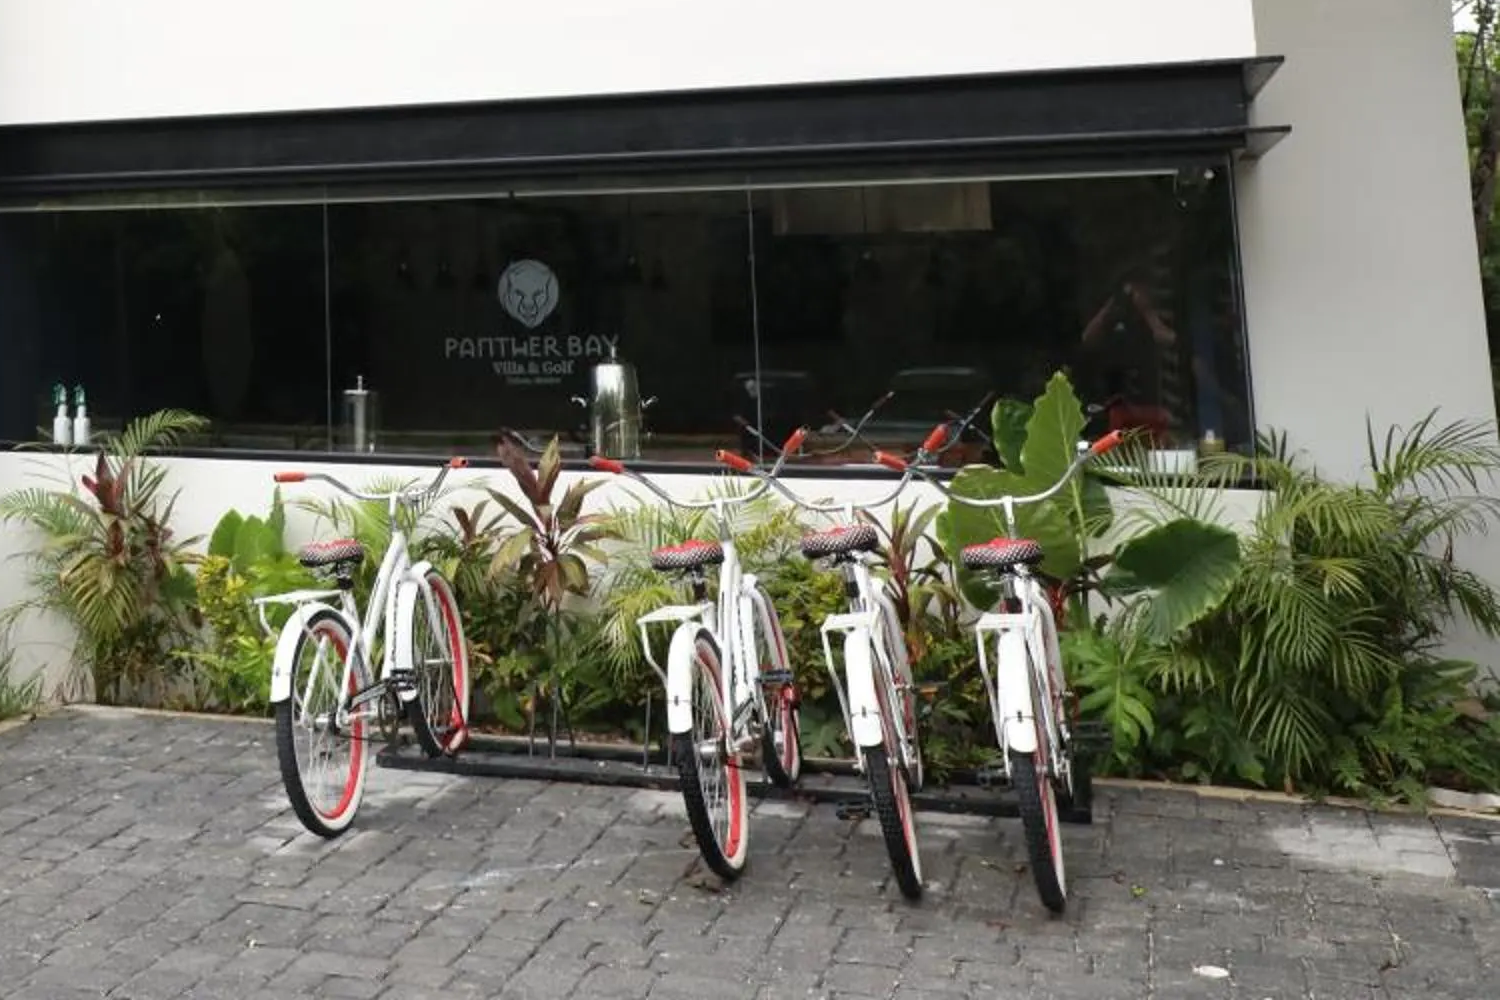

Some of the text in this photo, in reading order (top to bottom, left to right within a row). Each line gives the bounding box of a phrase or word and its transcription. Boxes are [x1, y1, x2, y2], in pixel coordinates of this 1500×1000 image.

[445, 334, 619, 359] PANTHER BAY
[493, 360, 525, 374] Villa
[542, 359, 575, 374] Golf
